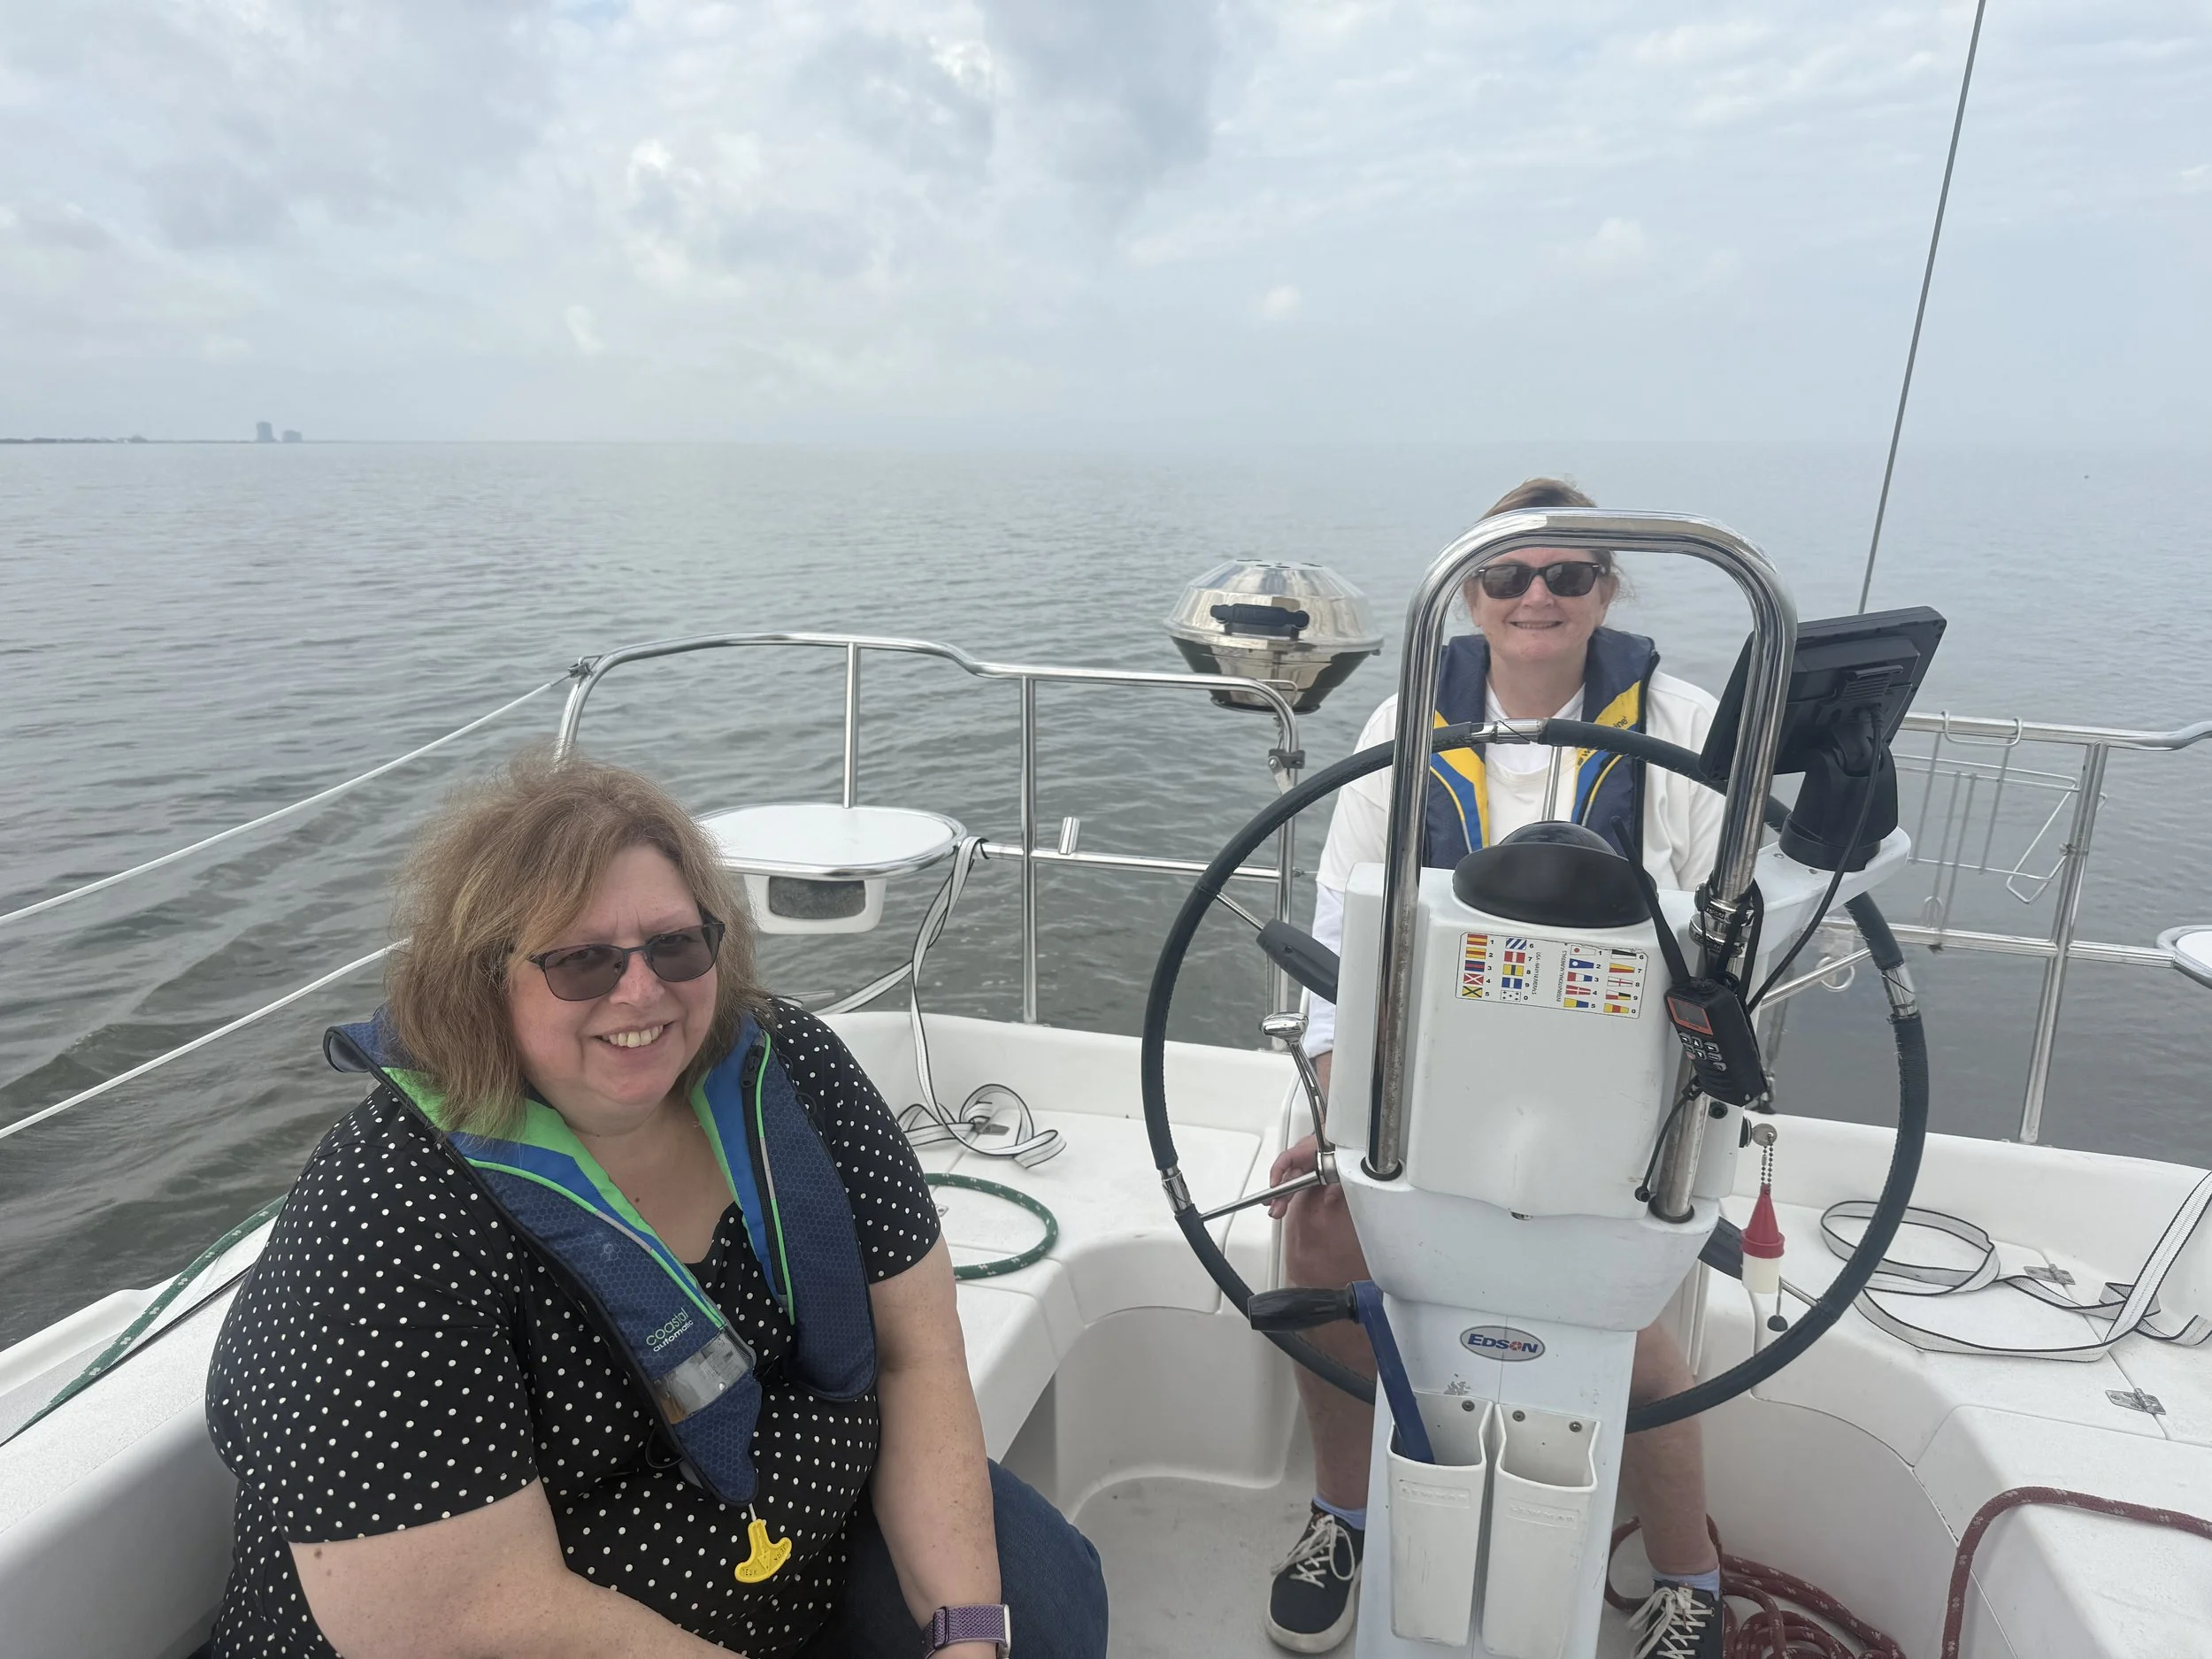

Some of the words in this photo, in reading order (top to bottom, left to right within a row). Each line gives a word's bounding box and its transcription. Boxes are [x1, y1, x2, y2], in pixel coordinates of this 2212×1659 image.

[646, 1307, 688, 1345] coastal
[653, 1320, 694, 1352] automatic
[1468, 1333, 1538, 1353] EDSON
